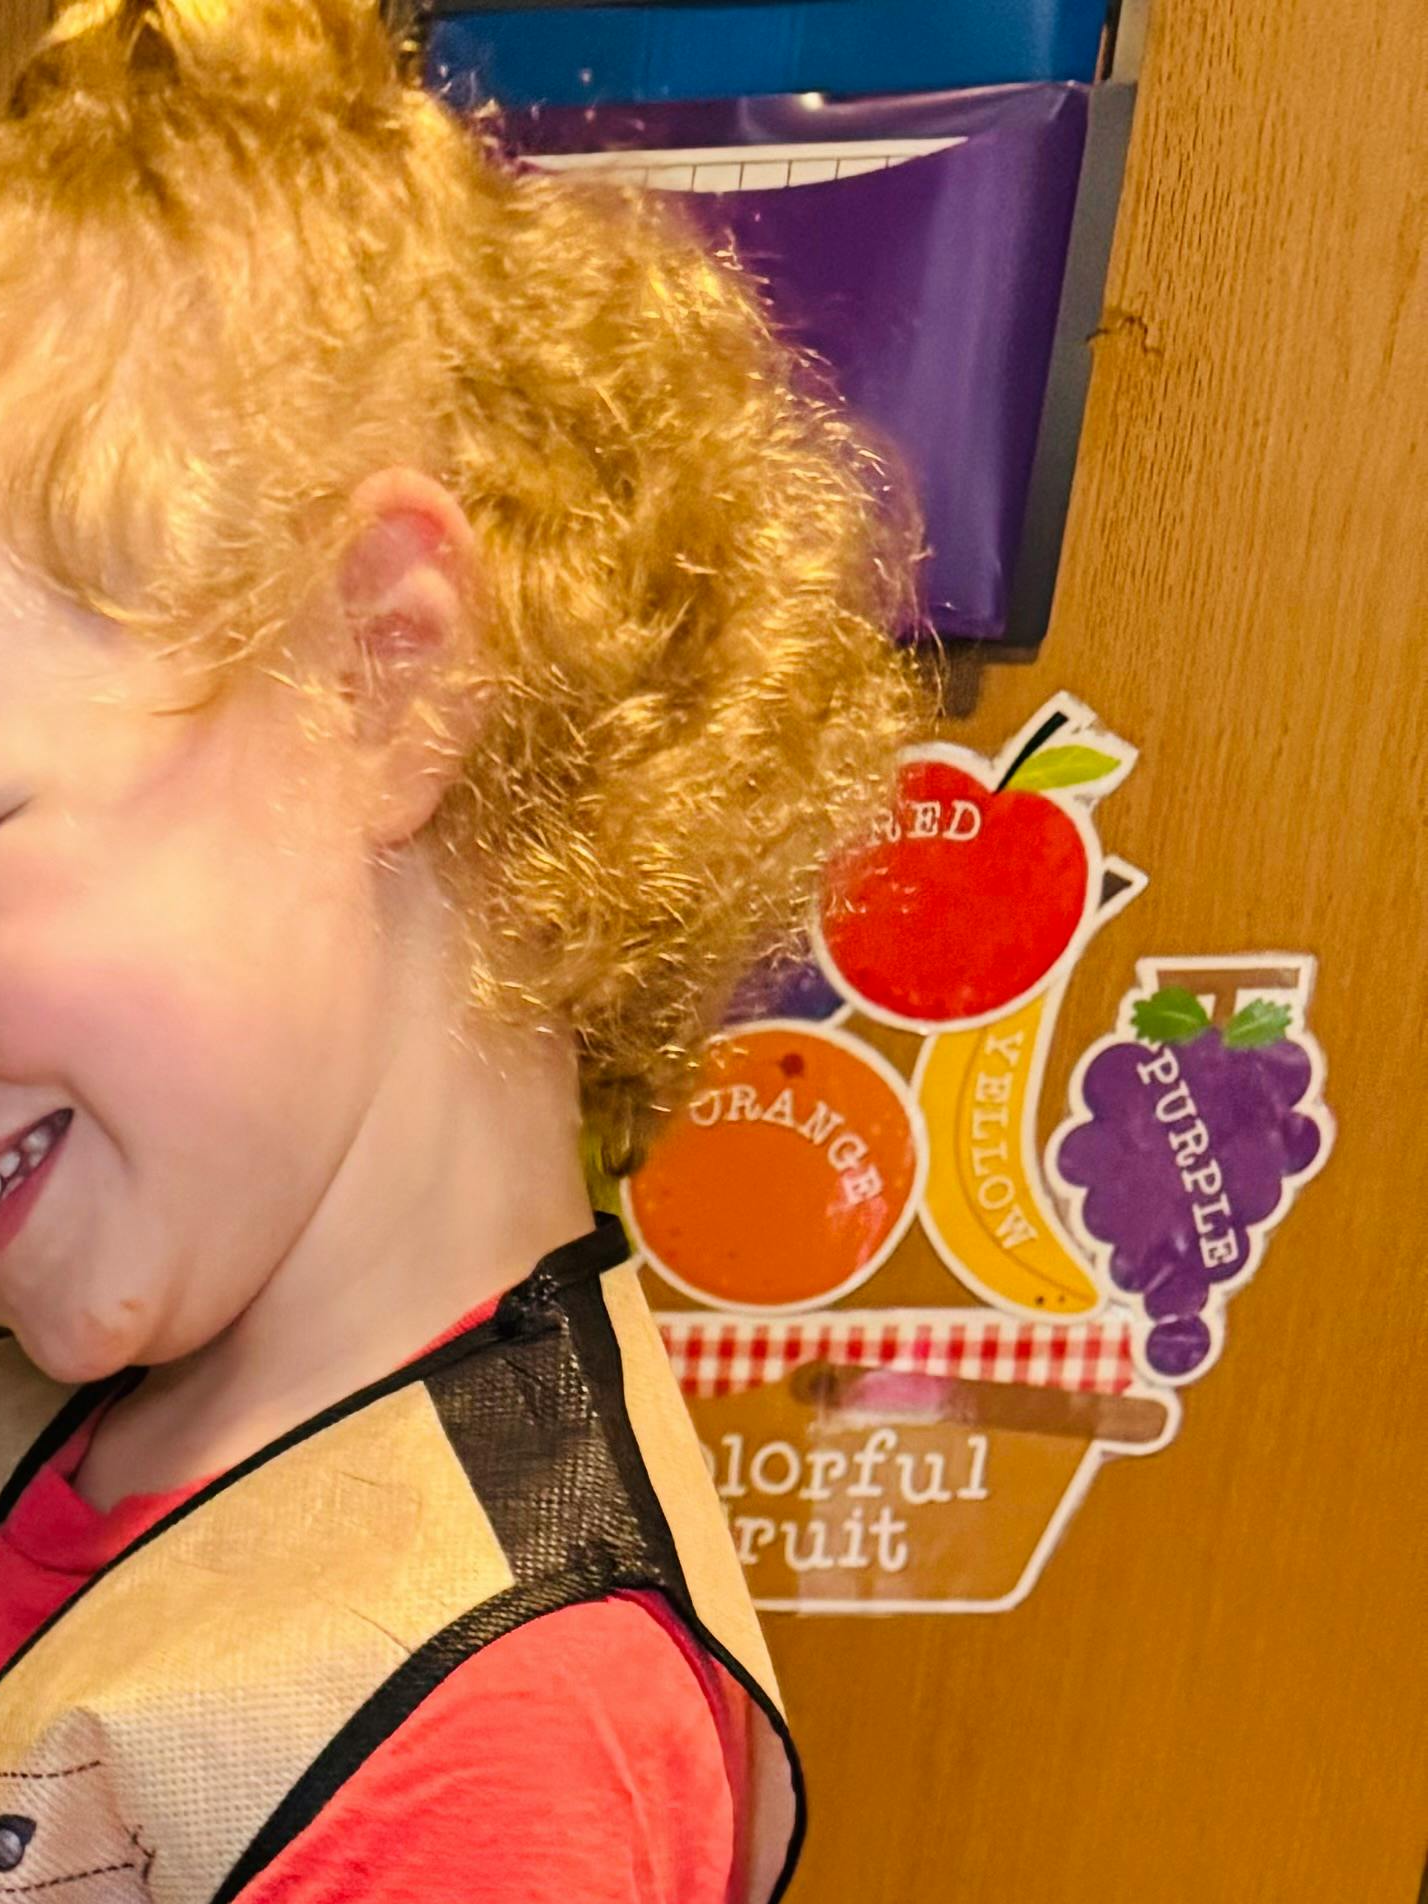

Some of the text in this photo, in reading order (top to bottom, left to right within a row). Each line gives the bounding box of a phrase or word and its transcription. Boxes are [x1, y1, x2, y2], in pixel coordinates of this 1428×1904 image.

[866, 799, 981, 847] RED
[689, 1083, 884, 1207] ORANGE
[971, 1030, 1038, 1250] YELLOW
[1137, 1044, 1239, 1268] PURPLE
[701, 1428, 989, 1504] lorful
[721, 1503, 910, 1572] ruit
